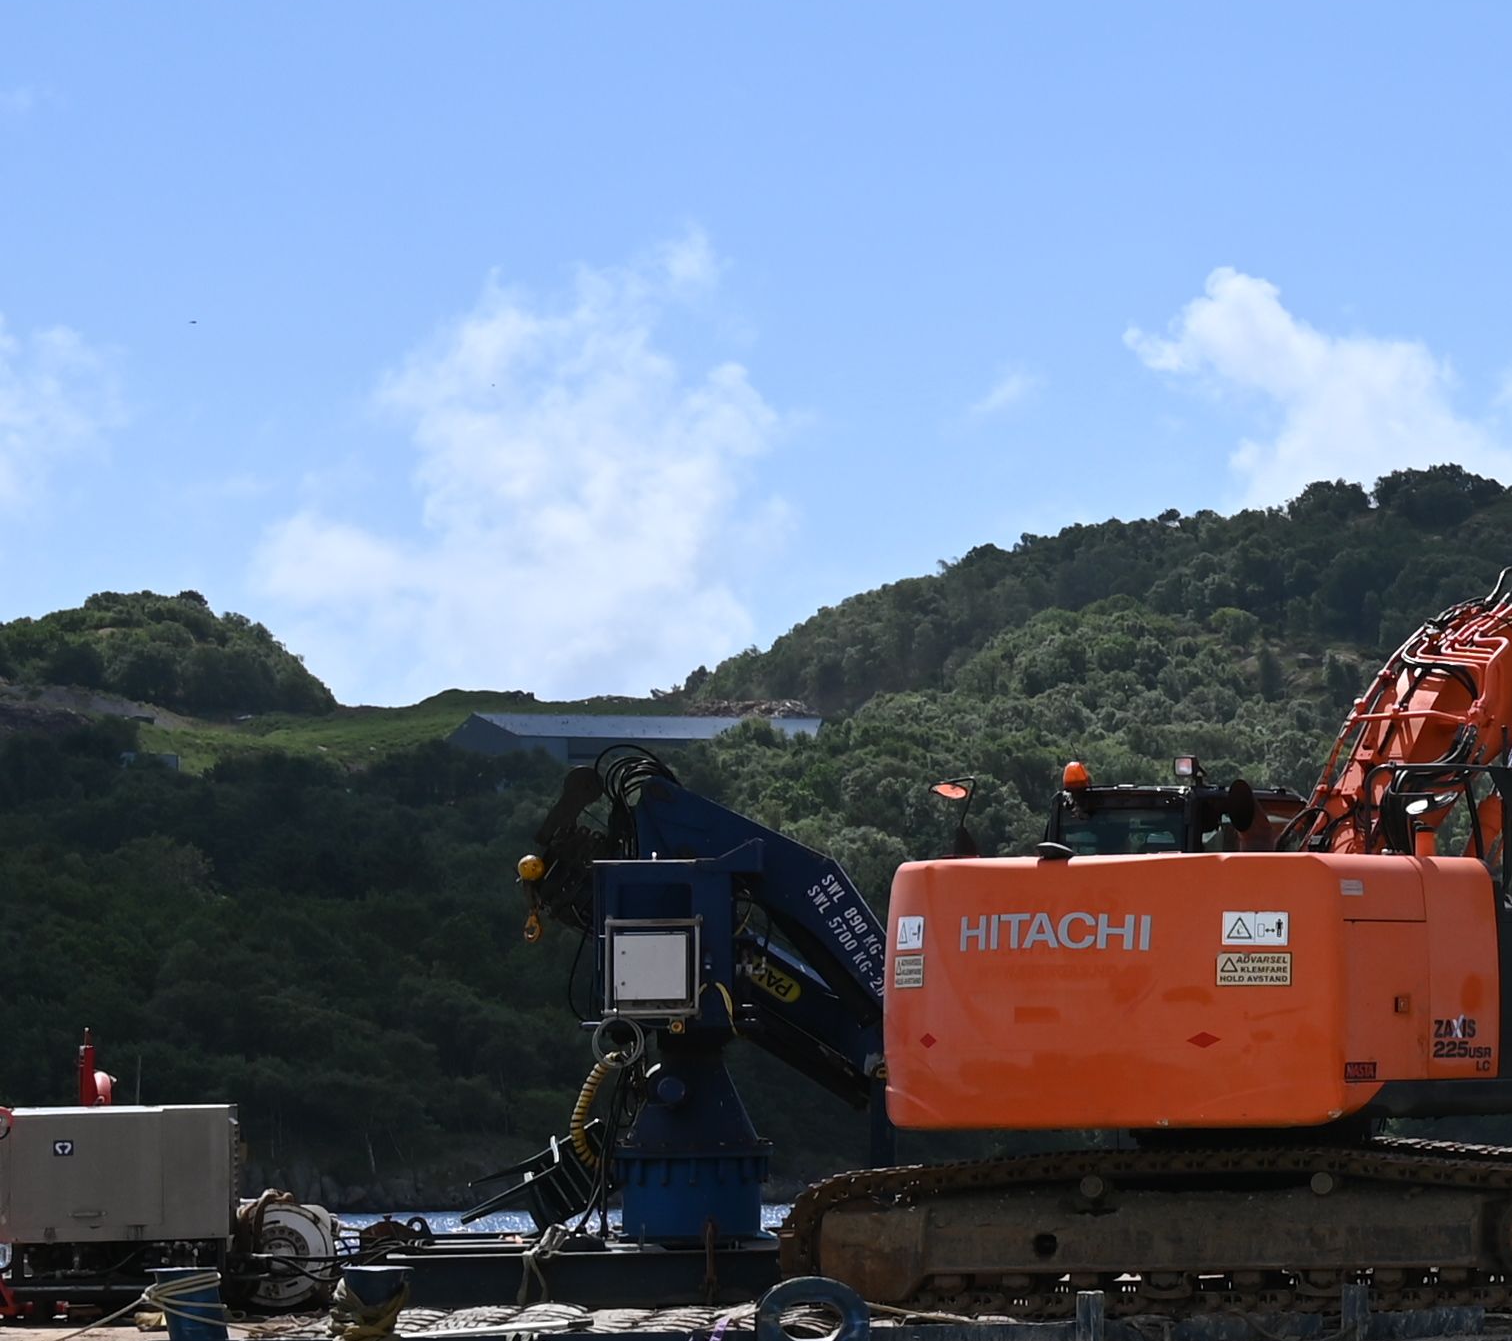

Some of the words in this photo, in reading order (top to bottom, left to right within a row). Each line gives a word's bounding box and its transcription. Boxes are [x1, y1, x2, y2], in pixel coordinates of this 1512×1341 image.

[807, 885, 831, 914] SWL
[828, 917, 858, 951] 5700
[822, 874, 845, 903] SWL
[844, 907, 868, 934] 890
[960, 912, 1153, 951] HITACHI
[1236, 955, 1288, 963] ADVARSEL
[1434, 1015, 1476, 1038] ZAXIS
[1476, 1061, 1490, 1071] LC
